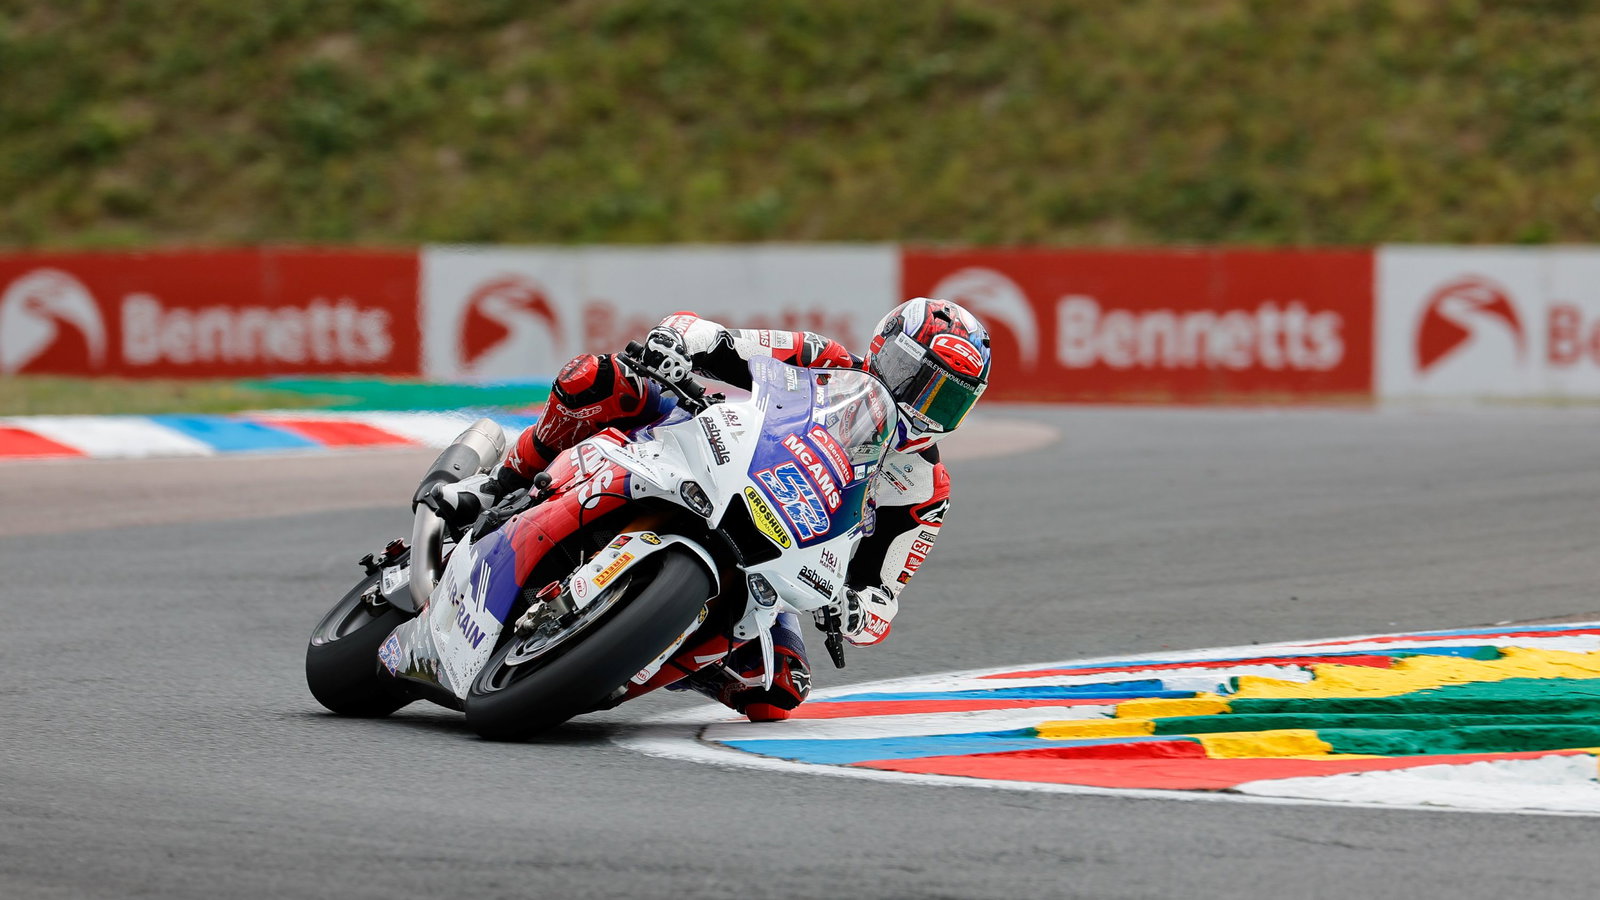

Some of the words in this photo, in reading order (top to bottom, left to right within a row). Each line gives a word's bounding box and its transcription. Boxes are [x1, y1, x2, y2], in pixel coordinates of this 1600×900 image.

[121, 295, 393, 366] Bennetts
[936, 337, 983, 369] LS2
[1056, 296, 1343, 369] Bennetts
[701, 416, 731, 464] ashvale
[827, 443, 850, 481] Bennetts
[784, 435, 839, 510] McAMS
[747, 490, 788, 545] BROSHUIS
[753, 508, 774, 536] HOLLAND
[756, 462, 830, 541] 52
[800, 565, 834, 592] ashvale
